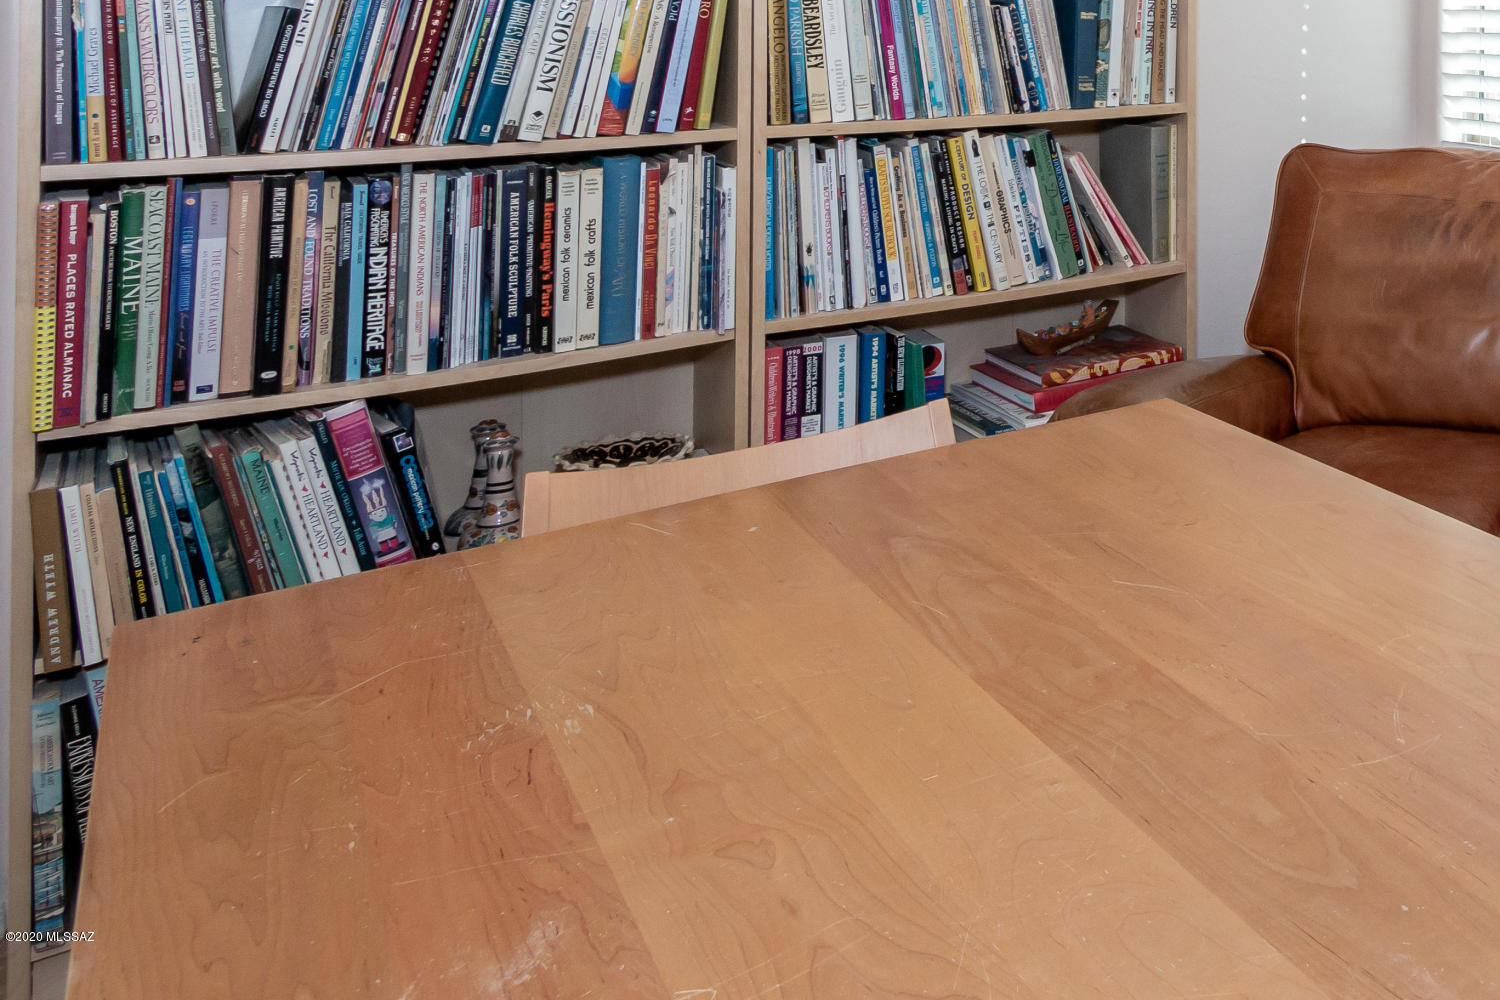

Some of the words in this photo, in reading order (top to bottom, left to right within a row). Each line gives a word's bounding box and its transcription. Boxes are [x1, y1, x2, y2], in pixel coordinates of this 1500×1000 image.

[503, 0, 532, 36] CHARLES
[789, 7, 803, 56] PARRISH
[802, 0, 824, 69] BEARDSLEY
[1023, 23, 1034, 47] INDIAN
[1146, 20, 1155, 33] IN
[491, 37, 523, 86] BURCHFIELD
[887, 44, 897, 74] Fantasy
[1145, 35, 1153, 55] INK
[139, 35, 160, 124] WATERCOLORS
[1028, 49, 1039, 78] DESIGNS
[891, 75, 900, 101] Worlds
[271, 187, 287, 222] AMERICAN
[307, 188, 318, 214] LOST
[417, 181, 428, 194] THE
[961, 183, 974, 221] DESIGN
[109, 209, 119, 244] BOSTON
[306, 216, 317, 238] AND
[417, 197, 427, 222] NORTH
[509, 191, 520, 238] AMERICAN
[563, 207, 572, 245] ceramics
[269, 224, 284, 259] PRIMITIVE
[416, 225, 427, 264] AMERICAN
[539, 202, 555, 281] Hemingway's
[586, 218, 598, 245] crafts
[303, 240, 315, 275] FOUND
[368, 247, 387, 290] INDIAN
[509, 240, 519, 263] FOLK
[560, 247, 572, 263] folk
[585, 250, 597, 267] folk
[66, 253, 77, 298] PLACES
[121, 235, 142, 315] MAINE
[416, 265, 426, 296] INDIANS
[507, 265, 519, 318] SCULPTURE
[561, 267, 570, 302] mexican
[586, 272, 595, 310] mexican
[300, 279, 313, 339] TRADITIONS
[541, 284, 553, 317] Paris
[64, 301, 76, 338] RATED
[366, 292, 386, 352] HERITAGE
[871, 337, 879, 356] 1994
[62, 342, 74, 398] ALMANAC
[838, 366, 846, 399] WRITER'S
[871, 358, 879, 389] ARTIST'S
[303, 494, 329, 551] HEARTLAND
[320, 490, 346, 547] HEARTLAND
